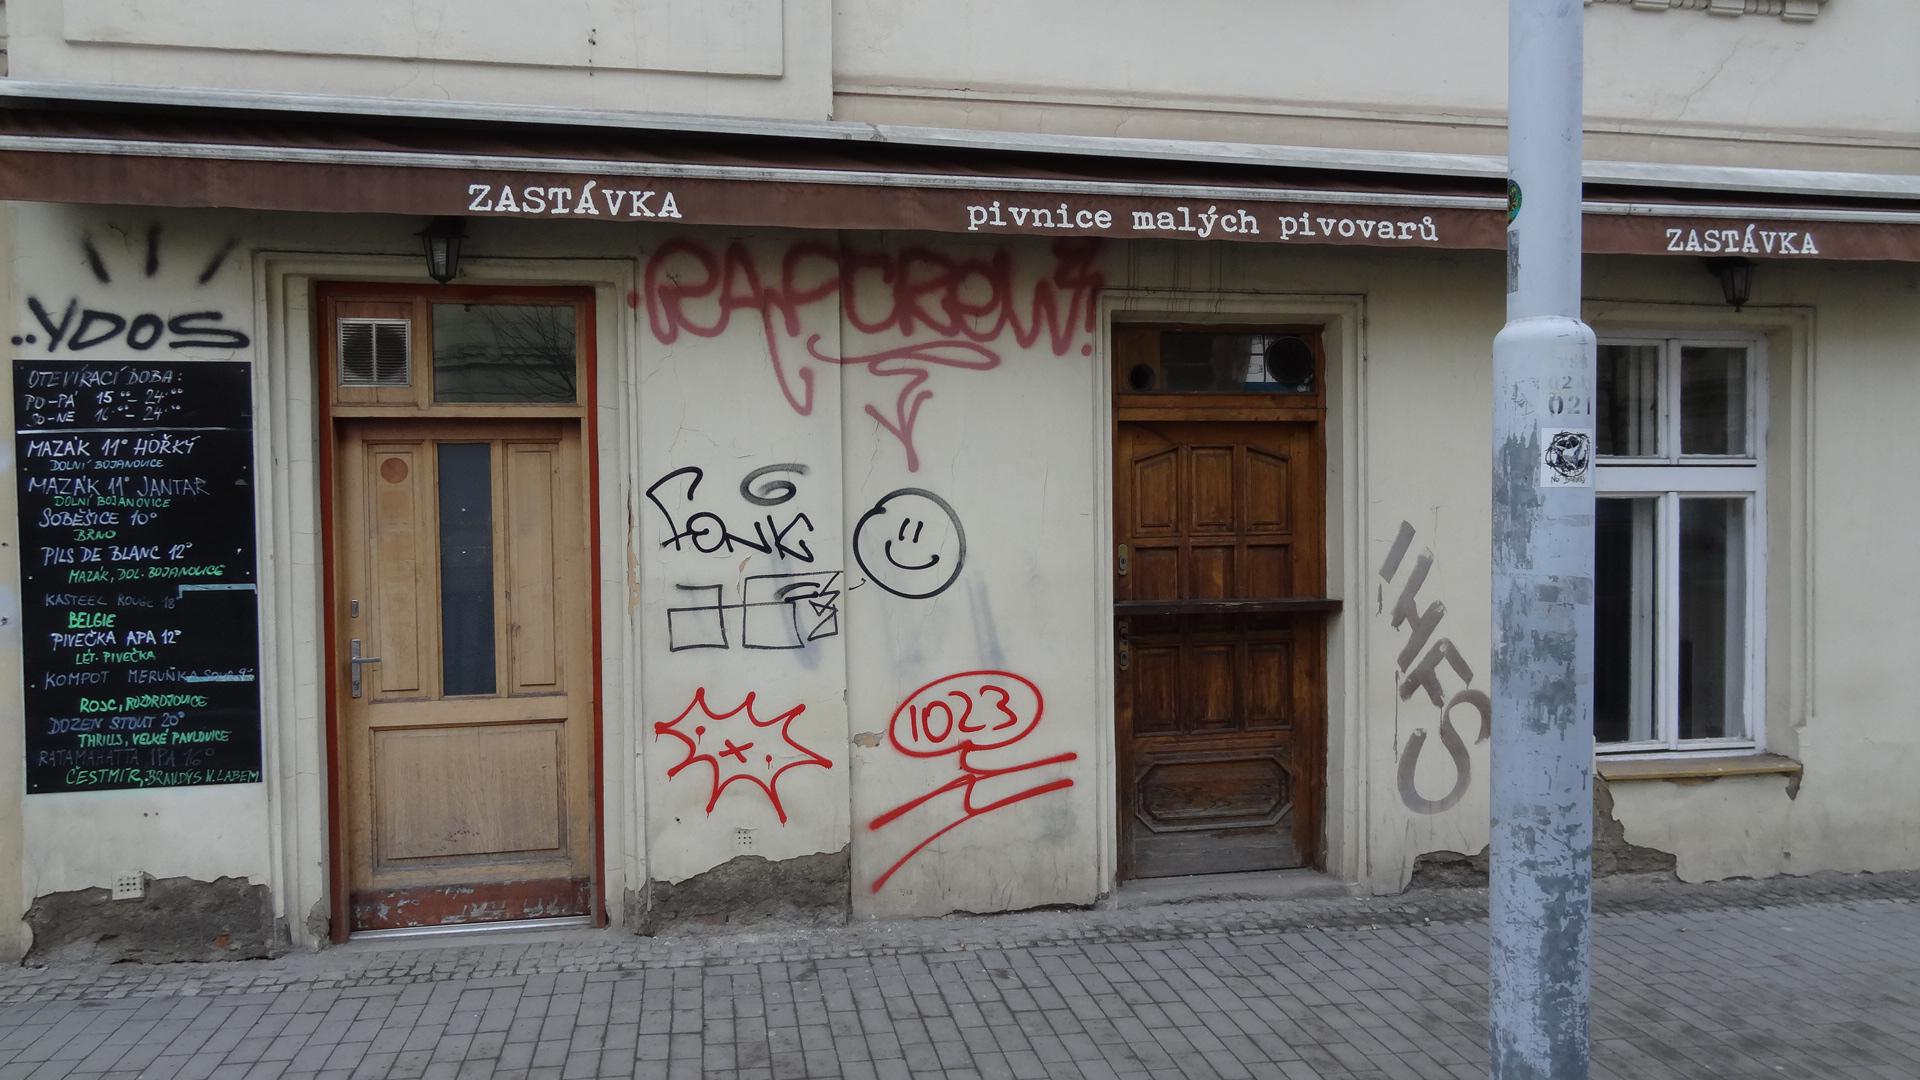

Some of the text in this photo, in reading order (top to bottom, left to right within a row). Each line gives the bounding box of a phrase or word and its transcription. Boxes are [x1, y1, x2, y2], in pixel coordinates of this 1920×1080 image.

[468, 180, 683, 218] ZASTÁVKA
[967, 201, 1439, 241] pivnice malých pivovarů
[1666, 224, 1820, 254] ZASTÁVKA
[28, 363, 128, 389] OTEVÍRACÍ
[27, 436, 91, 458] MAZÁK
[134, 434, 201, 456] HOŘKÝ
[50, 458, 164, 472] DOLNÍ BOJANOVICE
[28, 475, 100, 493] MAZÁK
[137, 476, 210, 496] JANTAR
[53, 494, 172, 508] DOLNÍ BOJANOVICE
[39, 508, 158, 527] SOBĚŠICE 10°
[73, 529, 117, 541] BRNO
[41, 546, 74, 566] PILS
[81, 546, 102, 562] DE
[111, 545, 161, 561] BLANC
[68, 611, 117, 629] BELGIE
[50, 630, 116, 651] PIVEČKA
[126, 630, 157, 646] APA
[103, 648, 156, 663] PIVEČKA
[45, 671, 110, 690] KOMPOT
[908, 684, 1018, 744] 1023
[48, 716, 101, 735] DOZEN
[109, 716, 157, 730] STOUT
[132, 728, 168, 744] VELKÉ
[171, 730, 232, 743] PAVLOVICE
[150, 749, 176, 767] IPA
